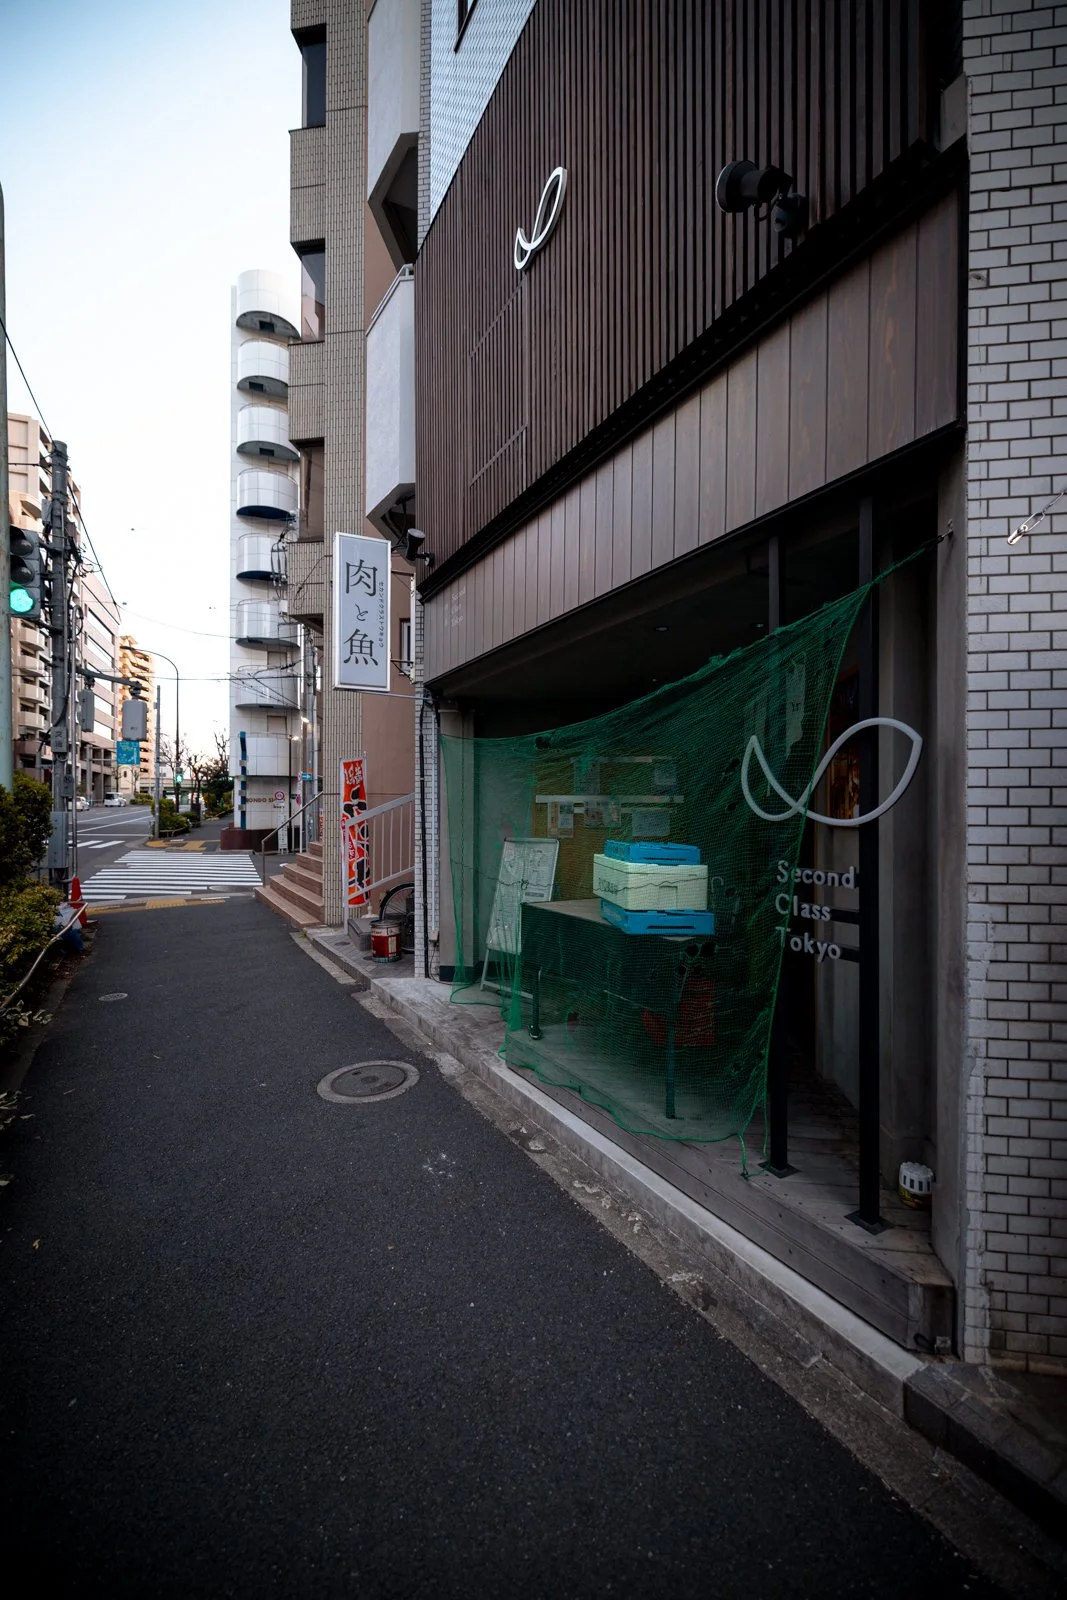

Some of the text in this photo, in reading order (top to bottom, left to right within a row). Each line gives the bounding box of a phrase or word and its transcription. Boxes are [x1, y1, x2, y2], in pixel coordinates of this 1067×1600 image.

[344, 559, 378, 666] 肉と魚
[776, 860, 855, 889] Second
[775, 893, 832, 922] Class
[775, 926, 841, 963] Tokyo
